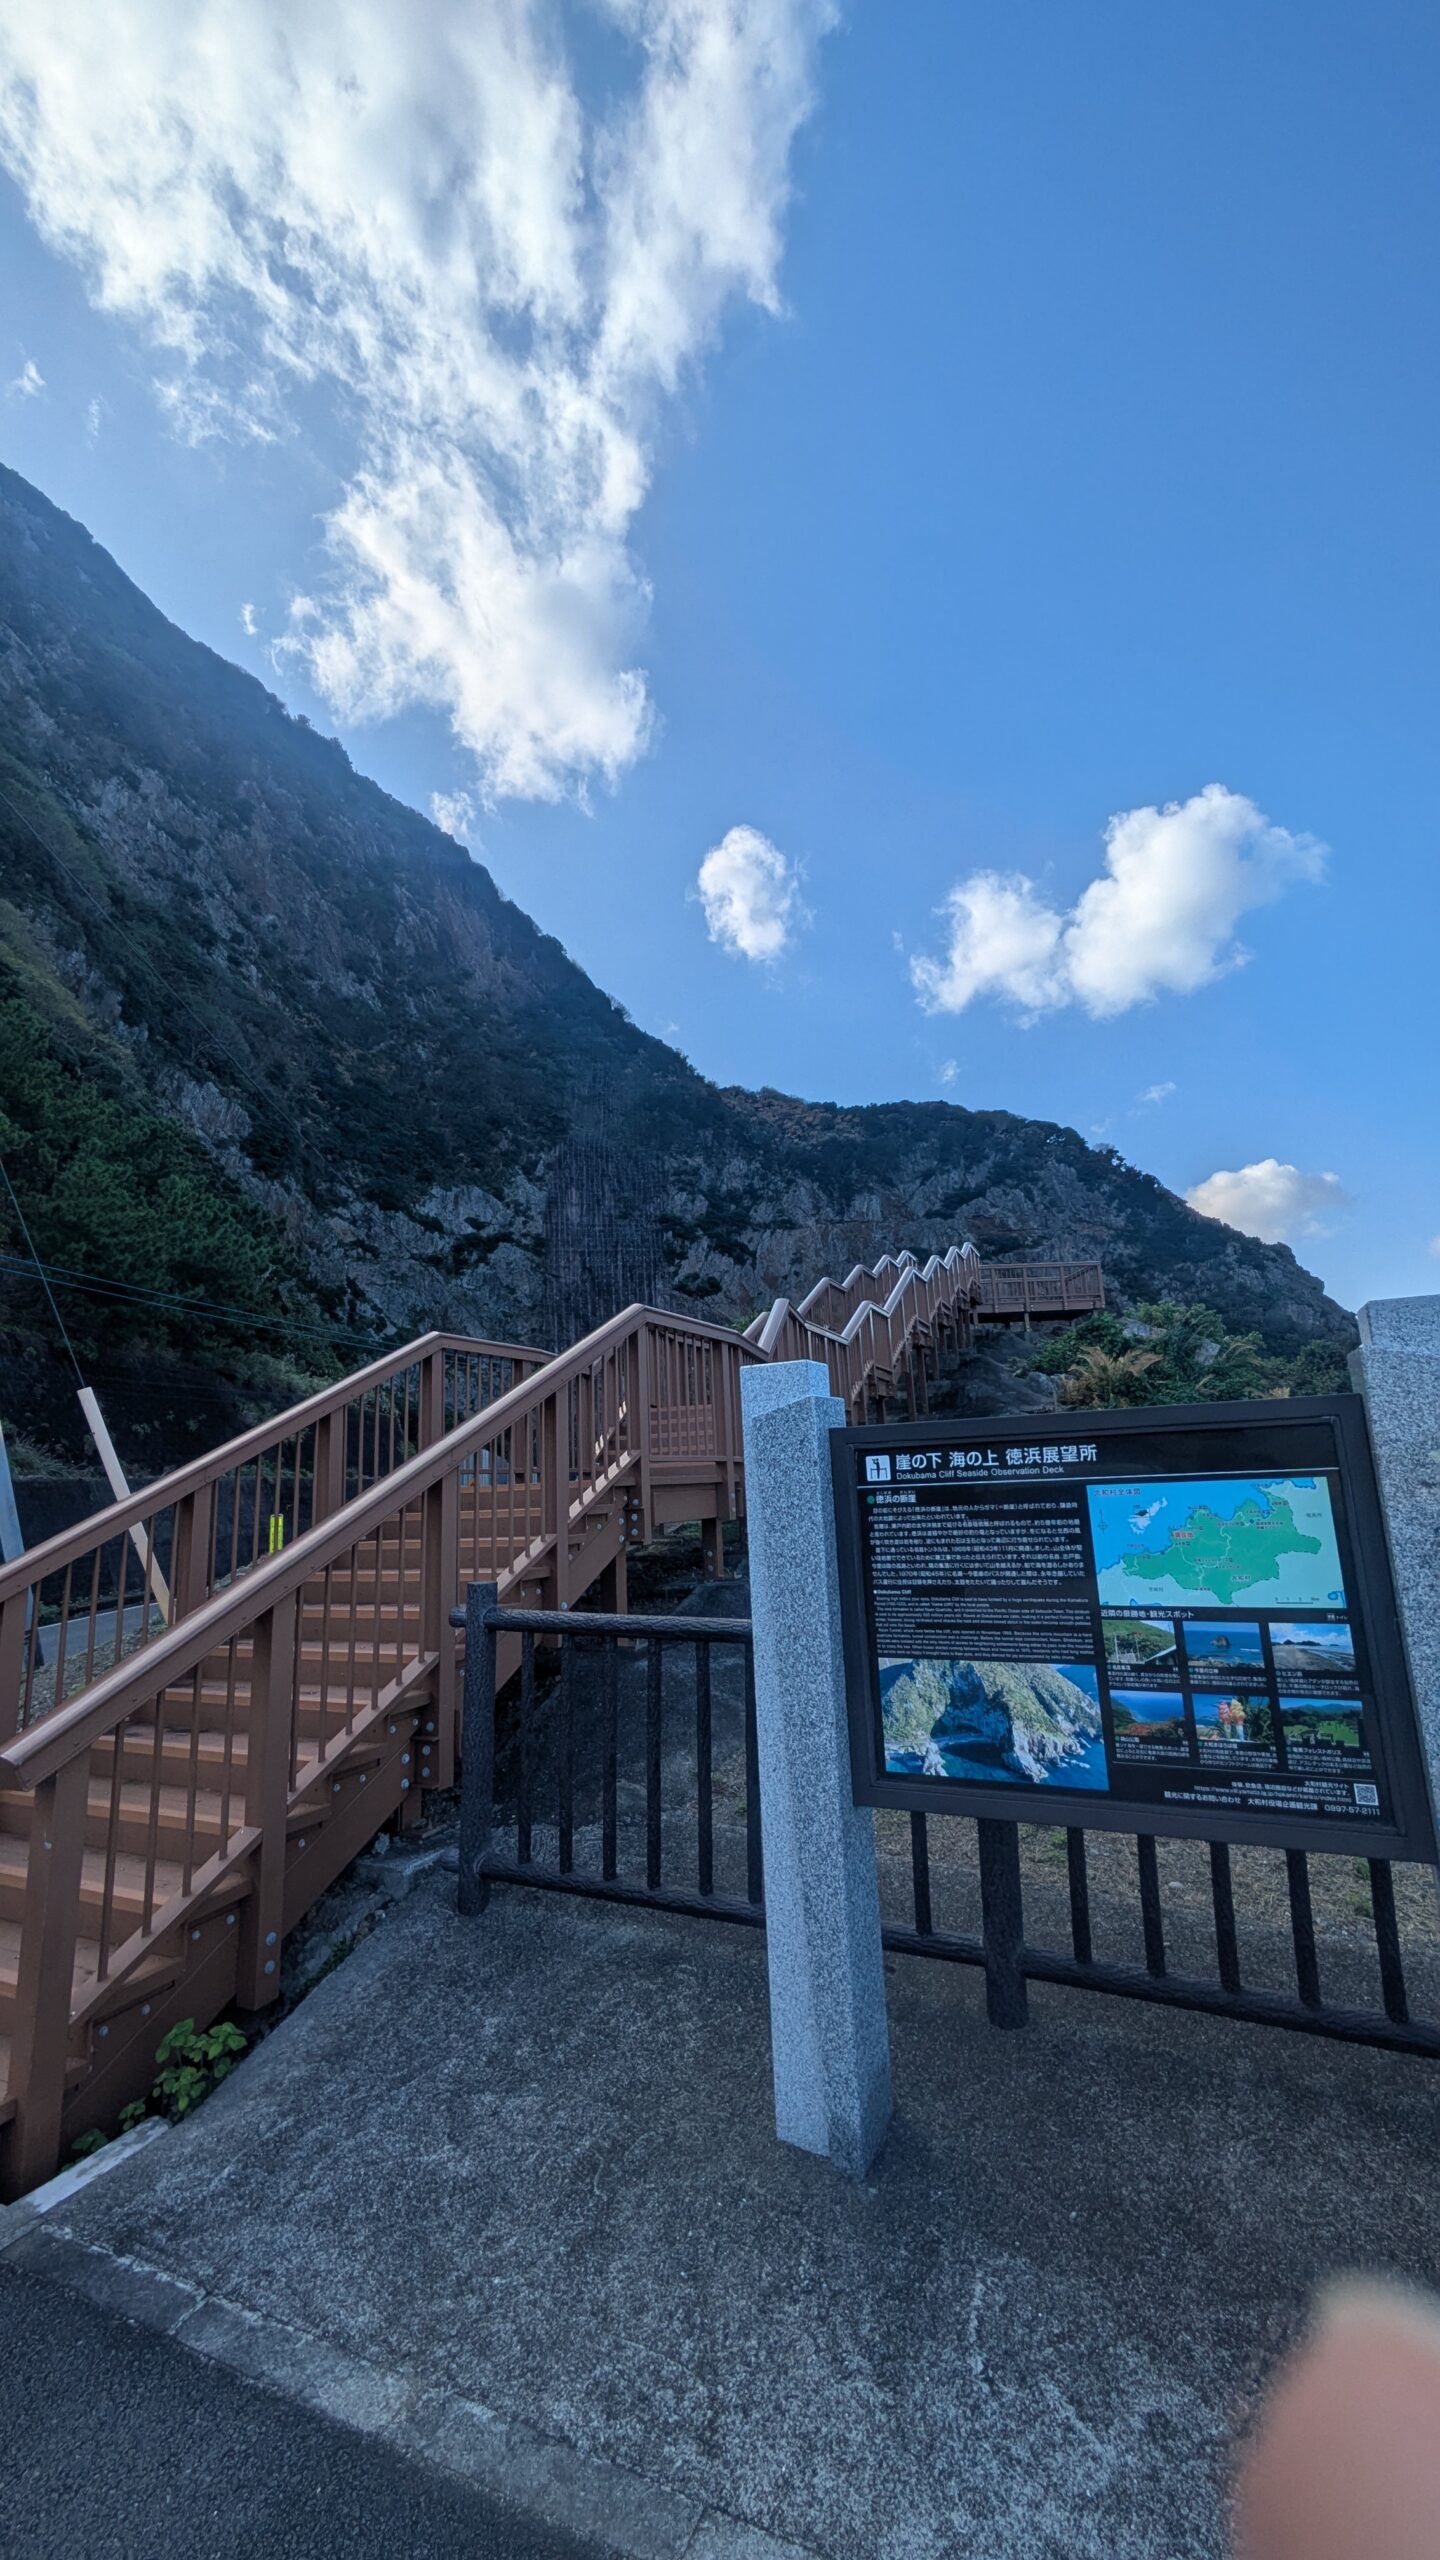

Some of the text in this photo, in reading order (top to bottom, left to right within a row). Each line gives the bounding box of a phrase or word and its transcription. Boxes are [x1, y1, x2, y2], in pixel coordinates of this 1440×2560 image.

[895, 1444, 1097, 1470] 崖の下 海の上 徳浜展望所
[896, 1465, 1064, 1480] Dokubama Cliff Seaside Observation Deck
[1164, 1790, 1241, 1804] 観光に関するお問い合わせ
[1248, 1798, 1318, 1810] 大和村役場企画観光課
